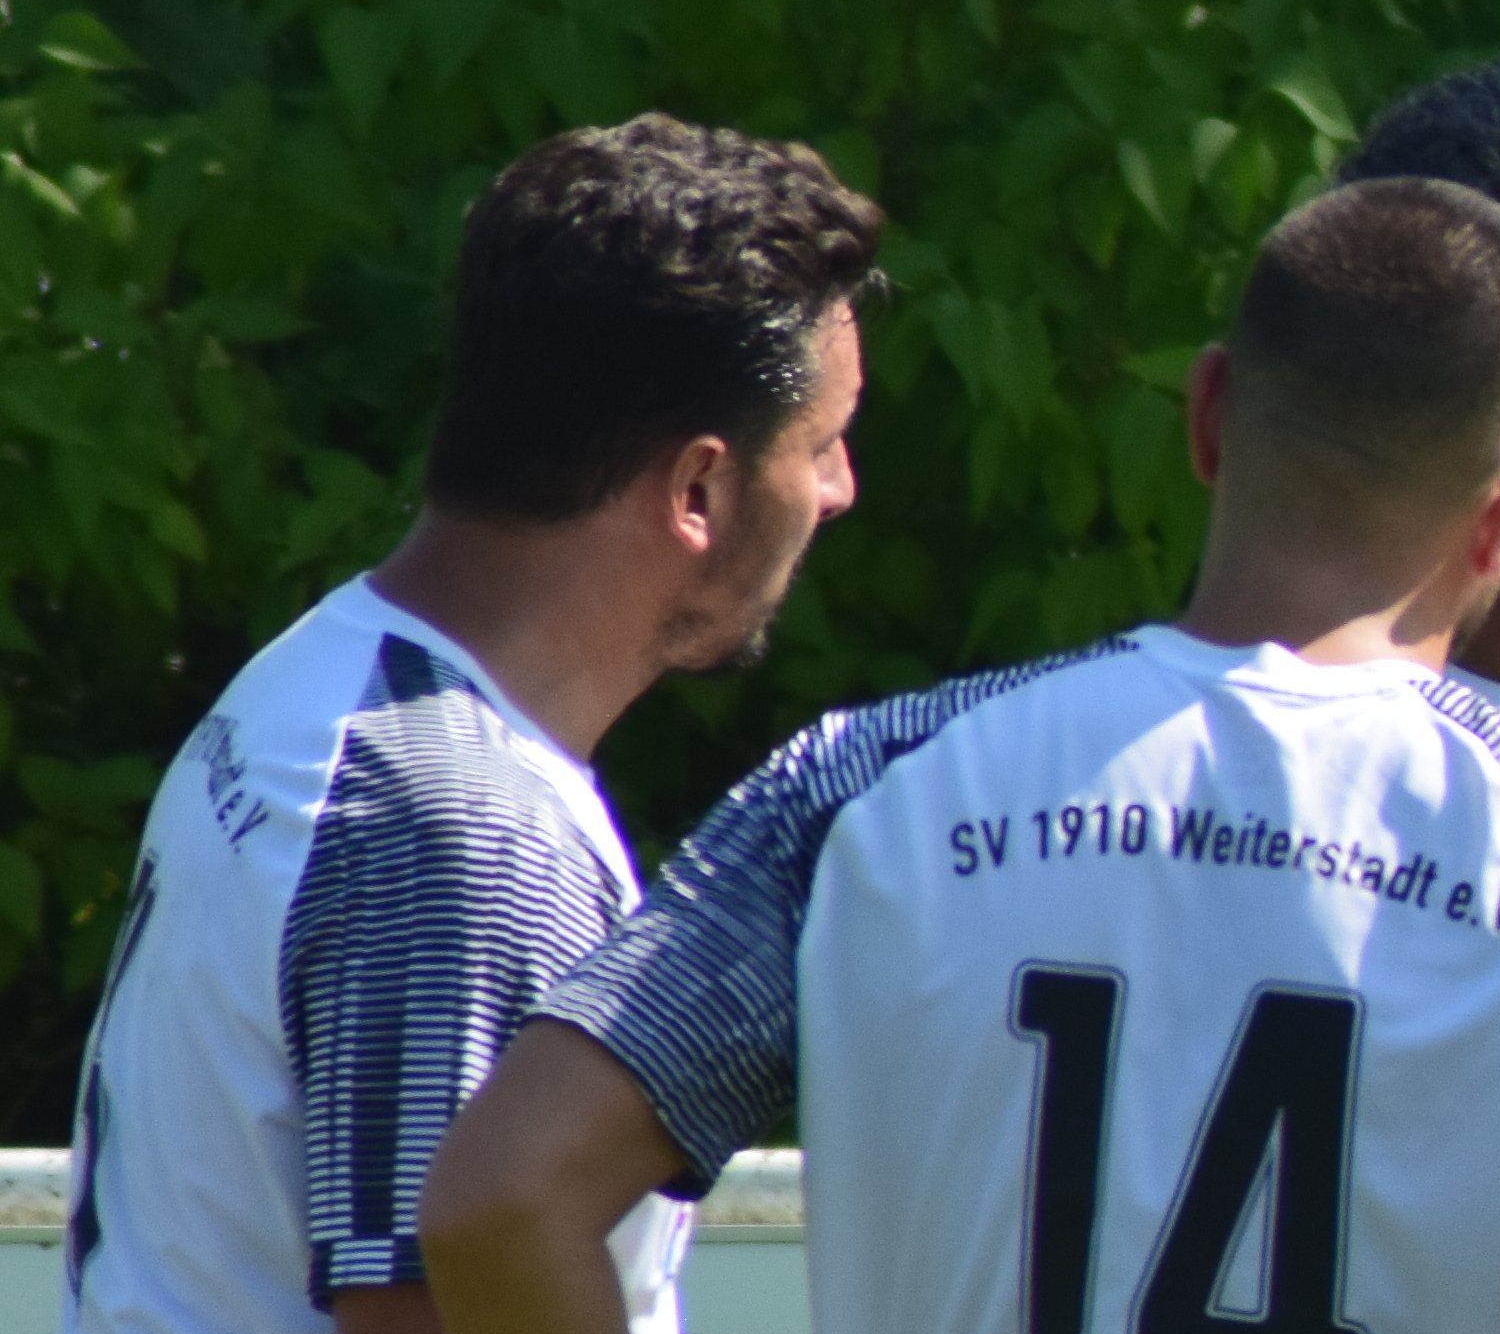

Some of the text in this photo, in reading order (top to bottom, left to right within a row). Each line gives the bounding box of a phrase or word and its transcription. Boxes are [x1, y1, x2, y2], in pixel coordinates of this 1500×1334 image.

[949, 816, 1010, 877] SV
[1031, 803, 1148, 860] 1910
[1171, 805, 1438, 910] Weiterstadt
[1445, 879, 1480, 928] e.
